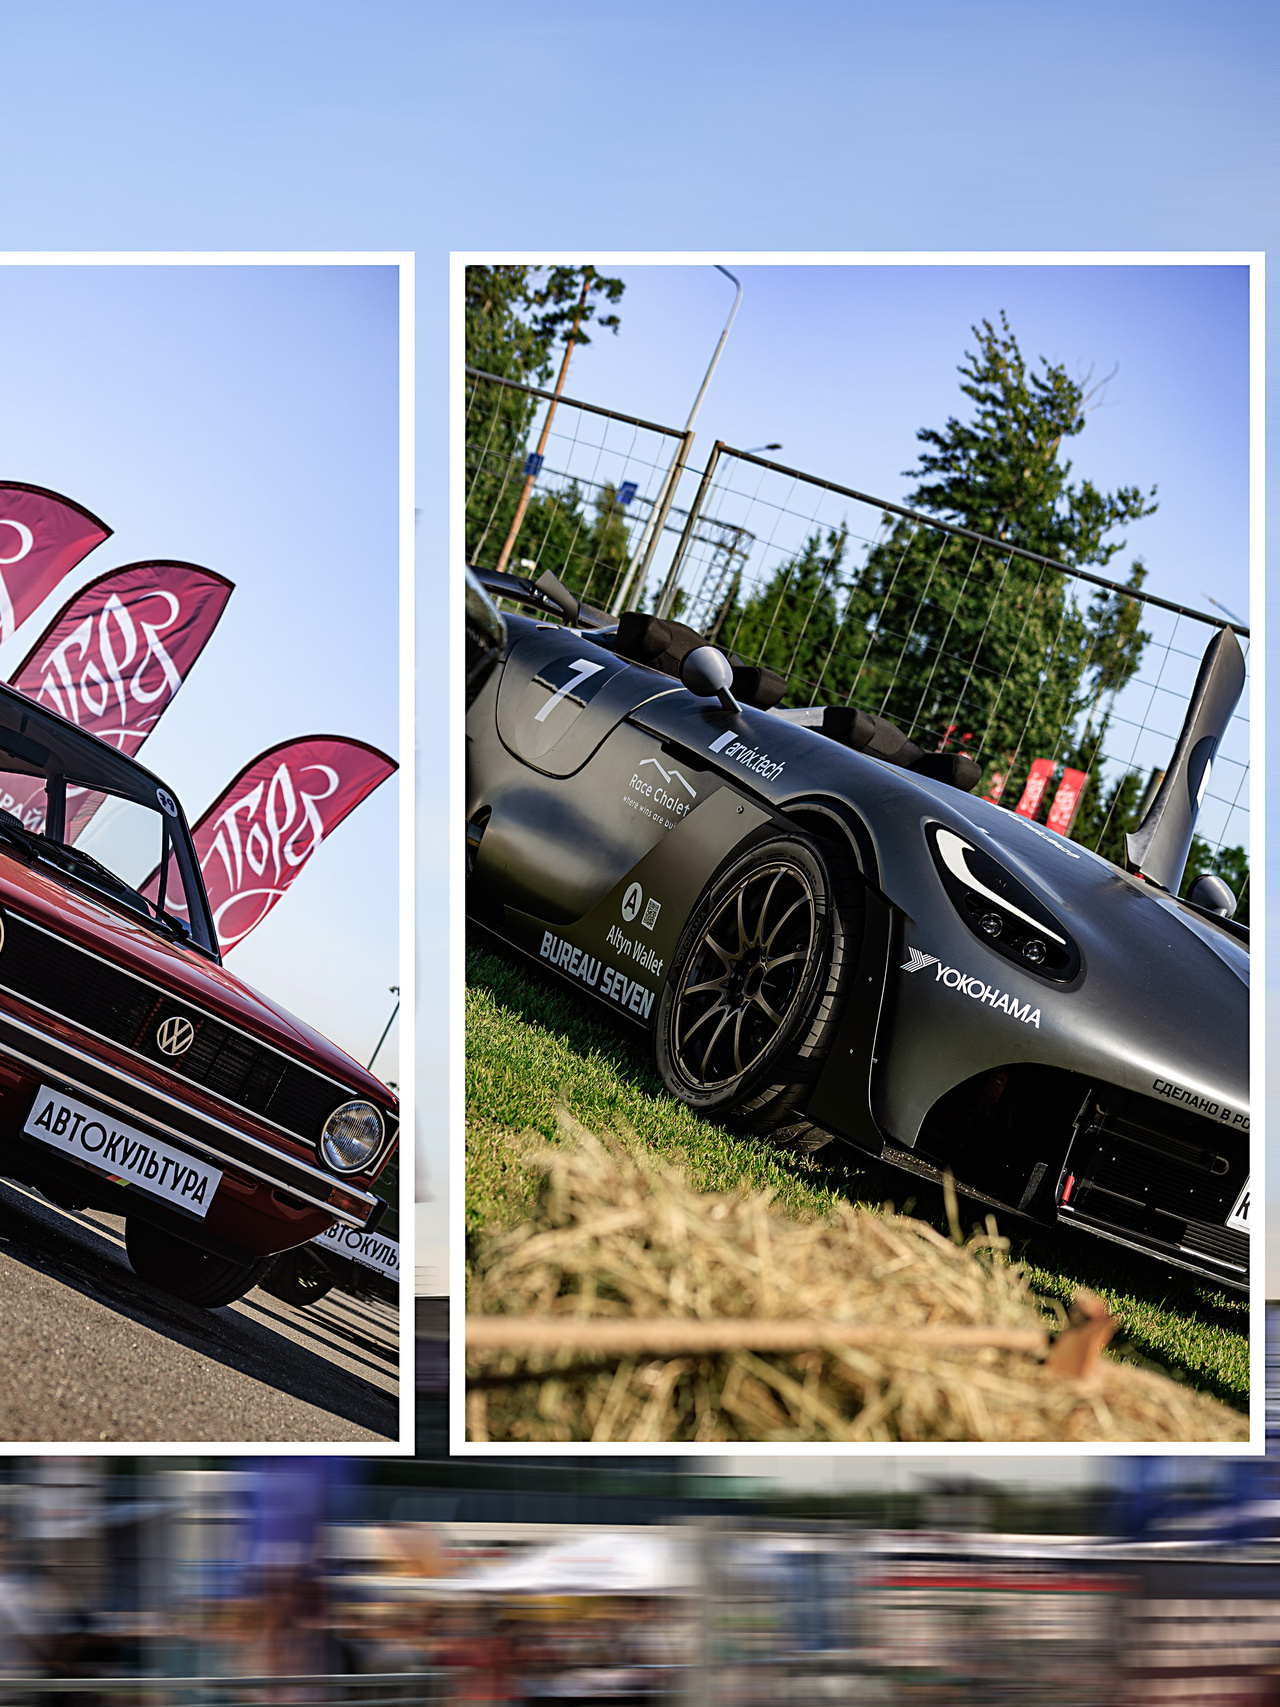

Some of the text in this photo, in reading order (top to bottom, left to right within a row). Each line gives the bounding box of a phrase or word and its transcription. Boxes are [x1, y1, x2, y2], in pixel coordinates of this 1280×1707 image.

[629, 773, 691, 818] Race Chalet
[605, 924, 664, 977] Altyn Wallet
[674, 910, 707, 968] YOKOHAMA
[539, 930, 655, 1020] BUREAU SEVEN
[935, 962, 1041, 1029] YOKOHAMA
[1152, 1078, 1220, 1116] СДЕЛАНО
[1219, 1108, 1232, 1121] В
[33, 1101, 209, 1205] АВТОКУЛЬТУРА
[323, 1222, 399, 1271] ВТОКУЛЬ
